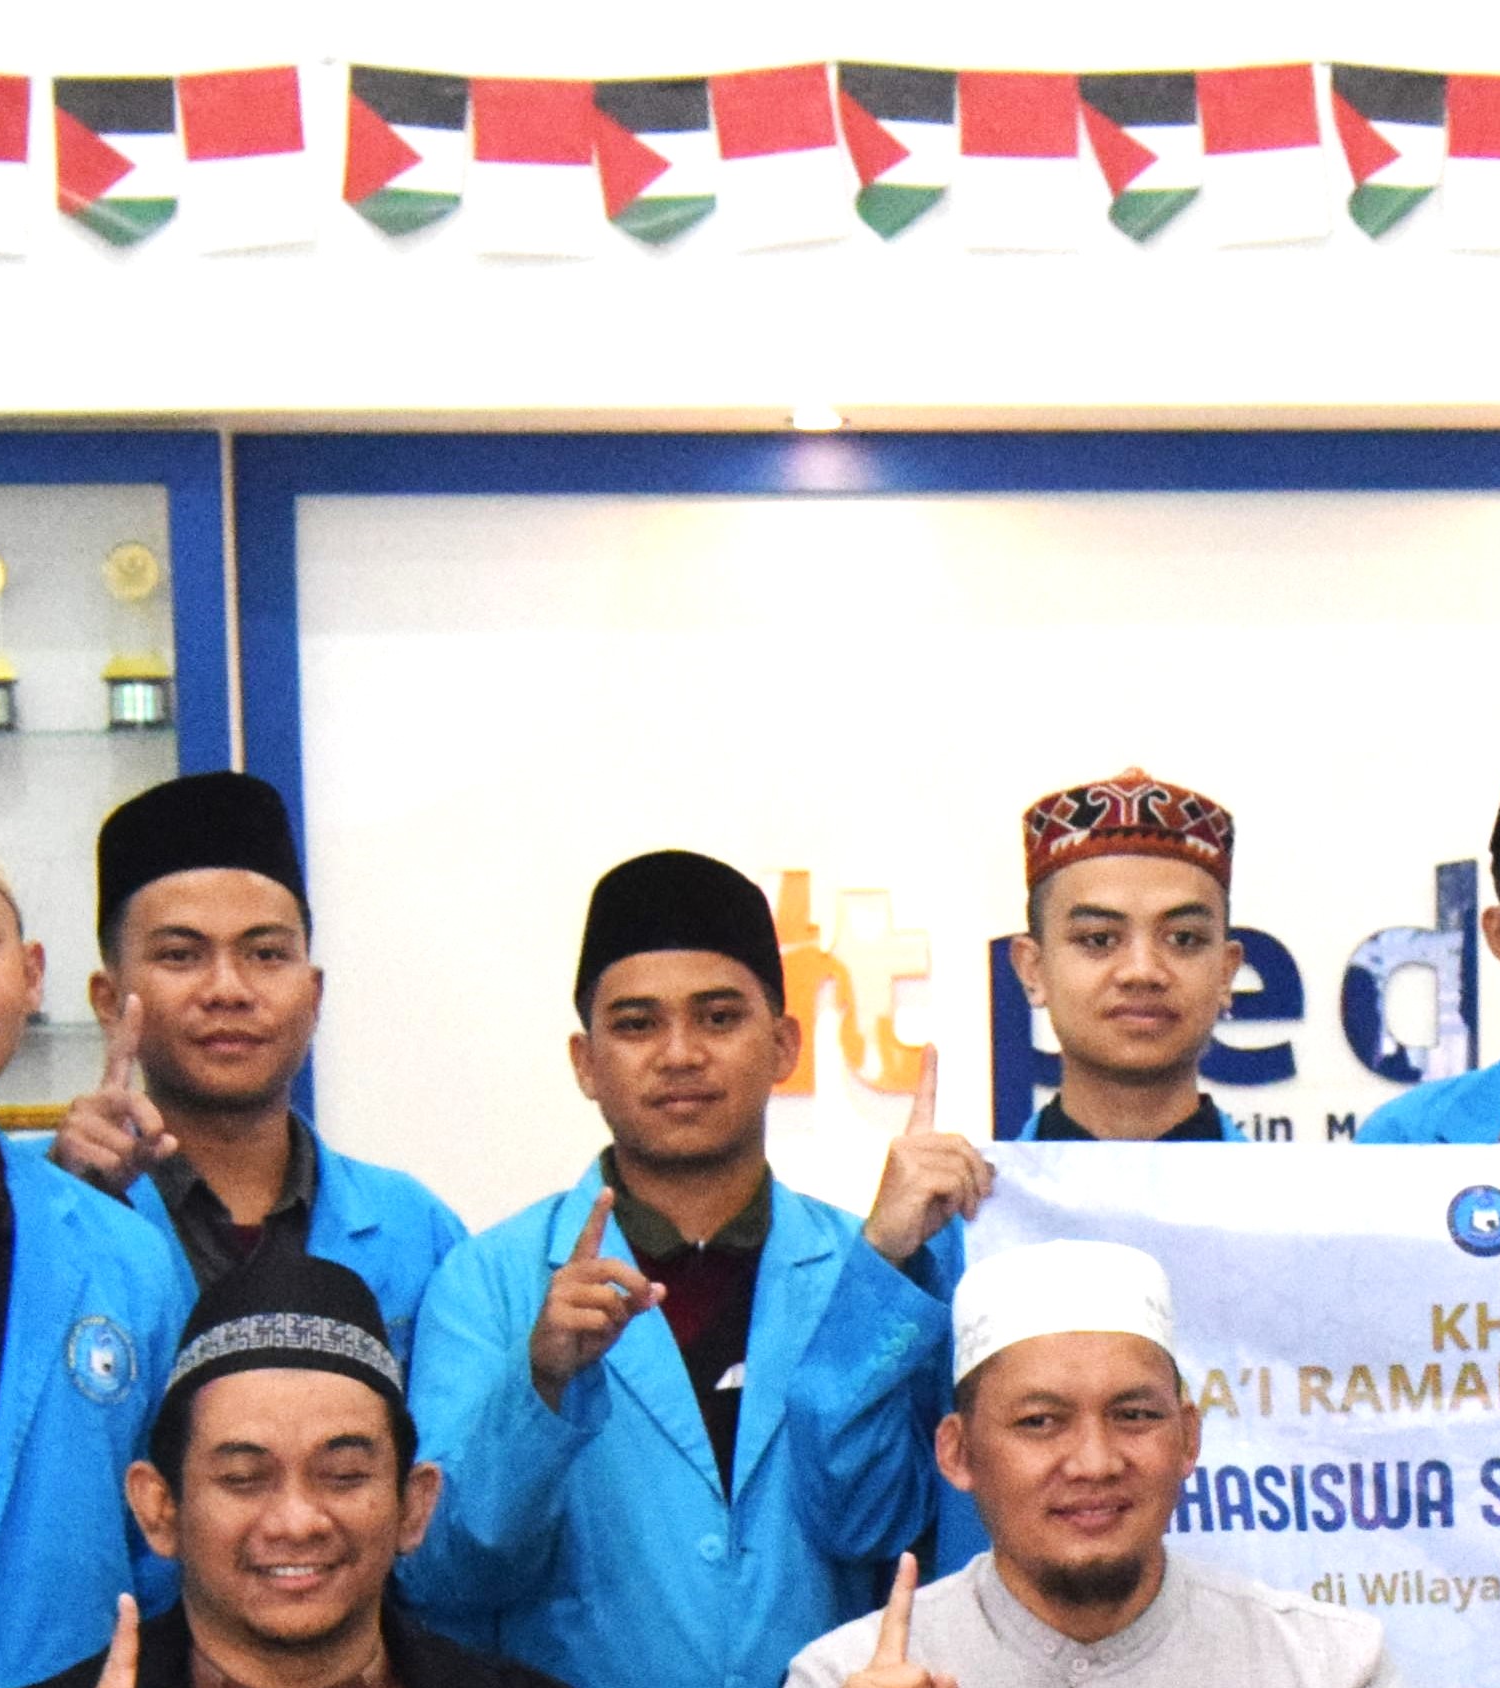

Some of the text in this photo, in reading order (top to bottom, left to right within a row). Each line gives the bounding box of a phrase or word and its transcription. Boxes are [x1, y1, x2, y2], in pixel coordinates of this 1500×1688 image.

[1180, 1365, 1273, 1419] A'I
[1165, 1459, 1455, 1534] HASISWA
[1310, 1571, 1348, 1607] di
